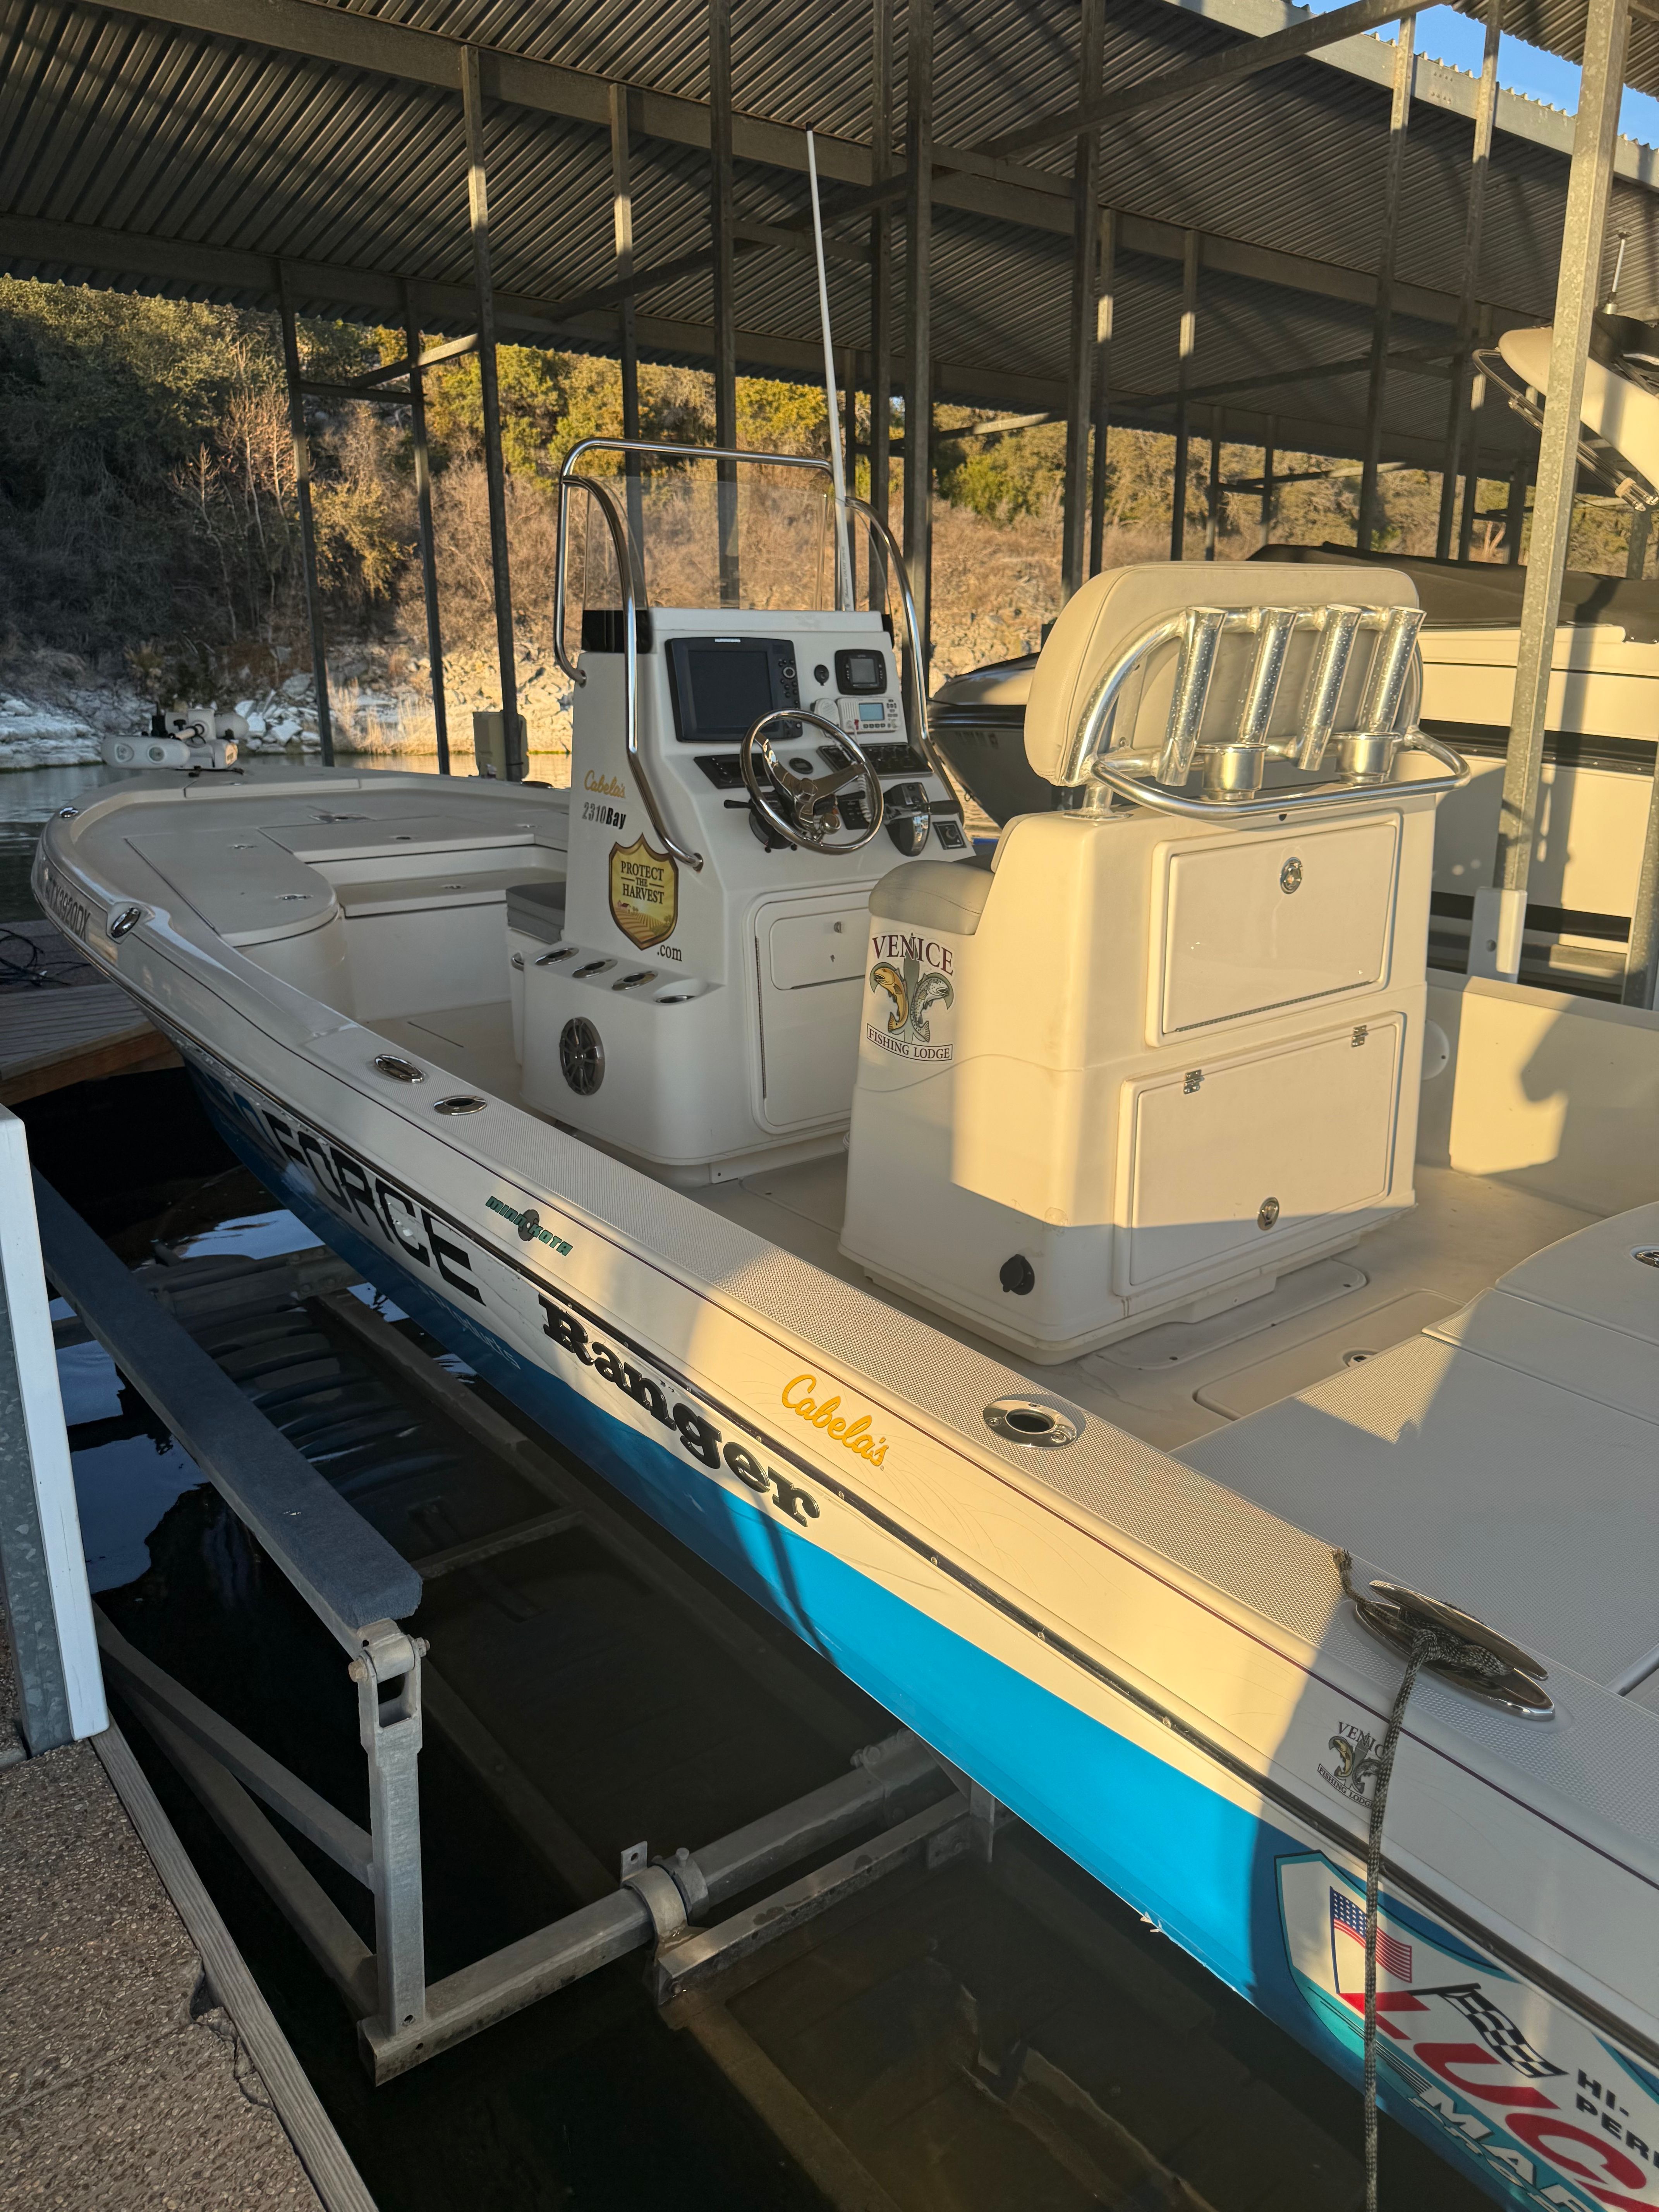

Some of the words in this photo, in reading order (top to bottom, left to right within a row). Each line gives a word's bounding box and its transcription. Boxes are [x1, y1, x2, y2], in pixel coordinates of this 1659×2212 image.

[584, 769, 625, 799] Cabela's
[621, 861, 664, 881] PROTECT
[635, 877, 648, 887] THE
[622, 883, 664, 904] HARVEST
[657, 945, 682, 962] .com
[872, 934, 953, 976] VENICE
[869, 1028, 909, 1055] FISHING
[913, 1046, 950, 1059] LODGE
[527, 1223, 573, 1257] KOTA
[539, 1293, 820, 1527] Ranger
[782, 1374, 889, 1467] Cabela's
[1338, 1721, 1384, 1760] VENIC
[1319, 1767, 1347, 1794] FISHING
[1578, 2068, 1630, 2117] HI-
[1576, 2092, 1659, 2169] PER
